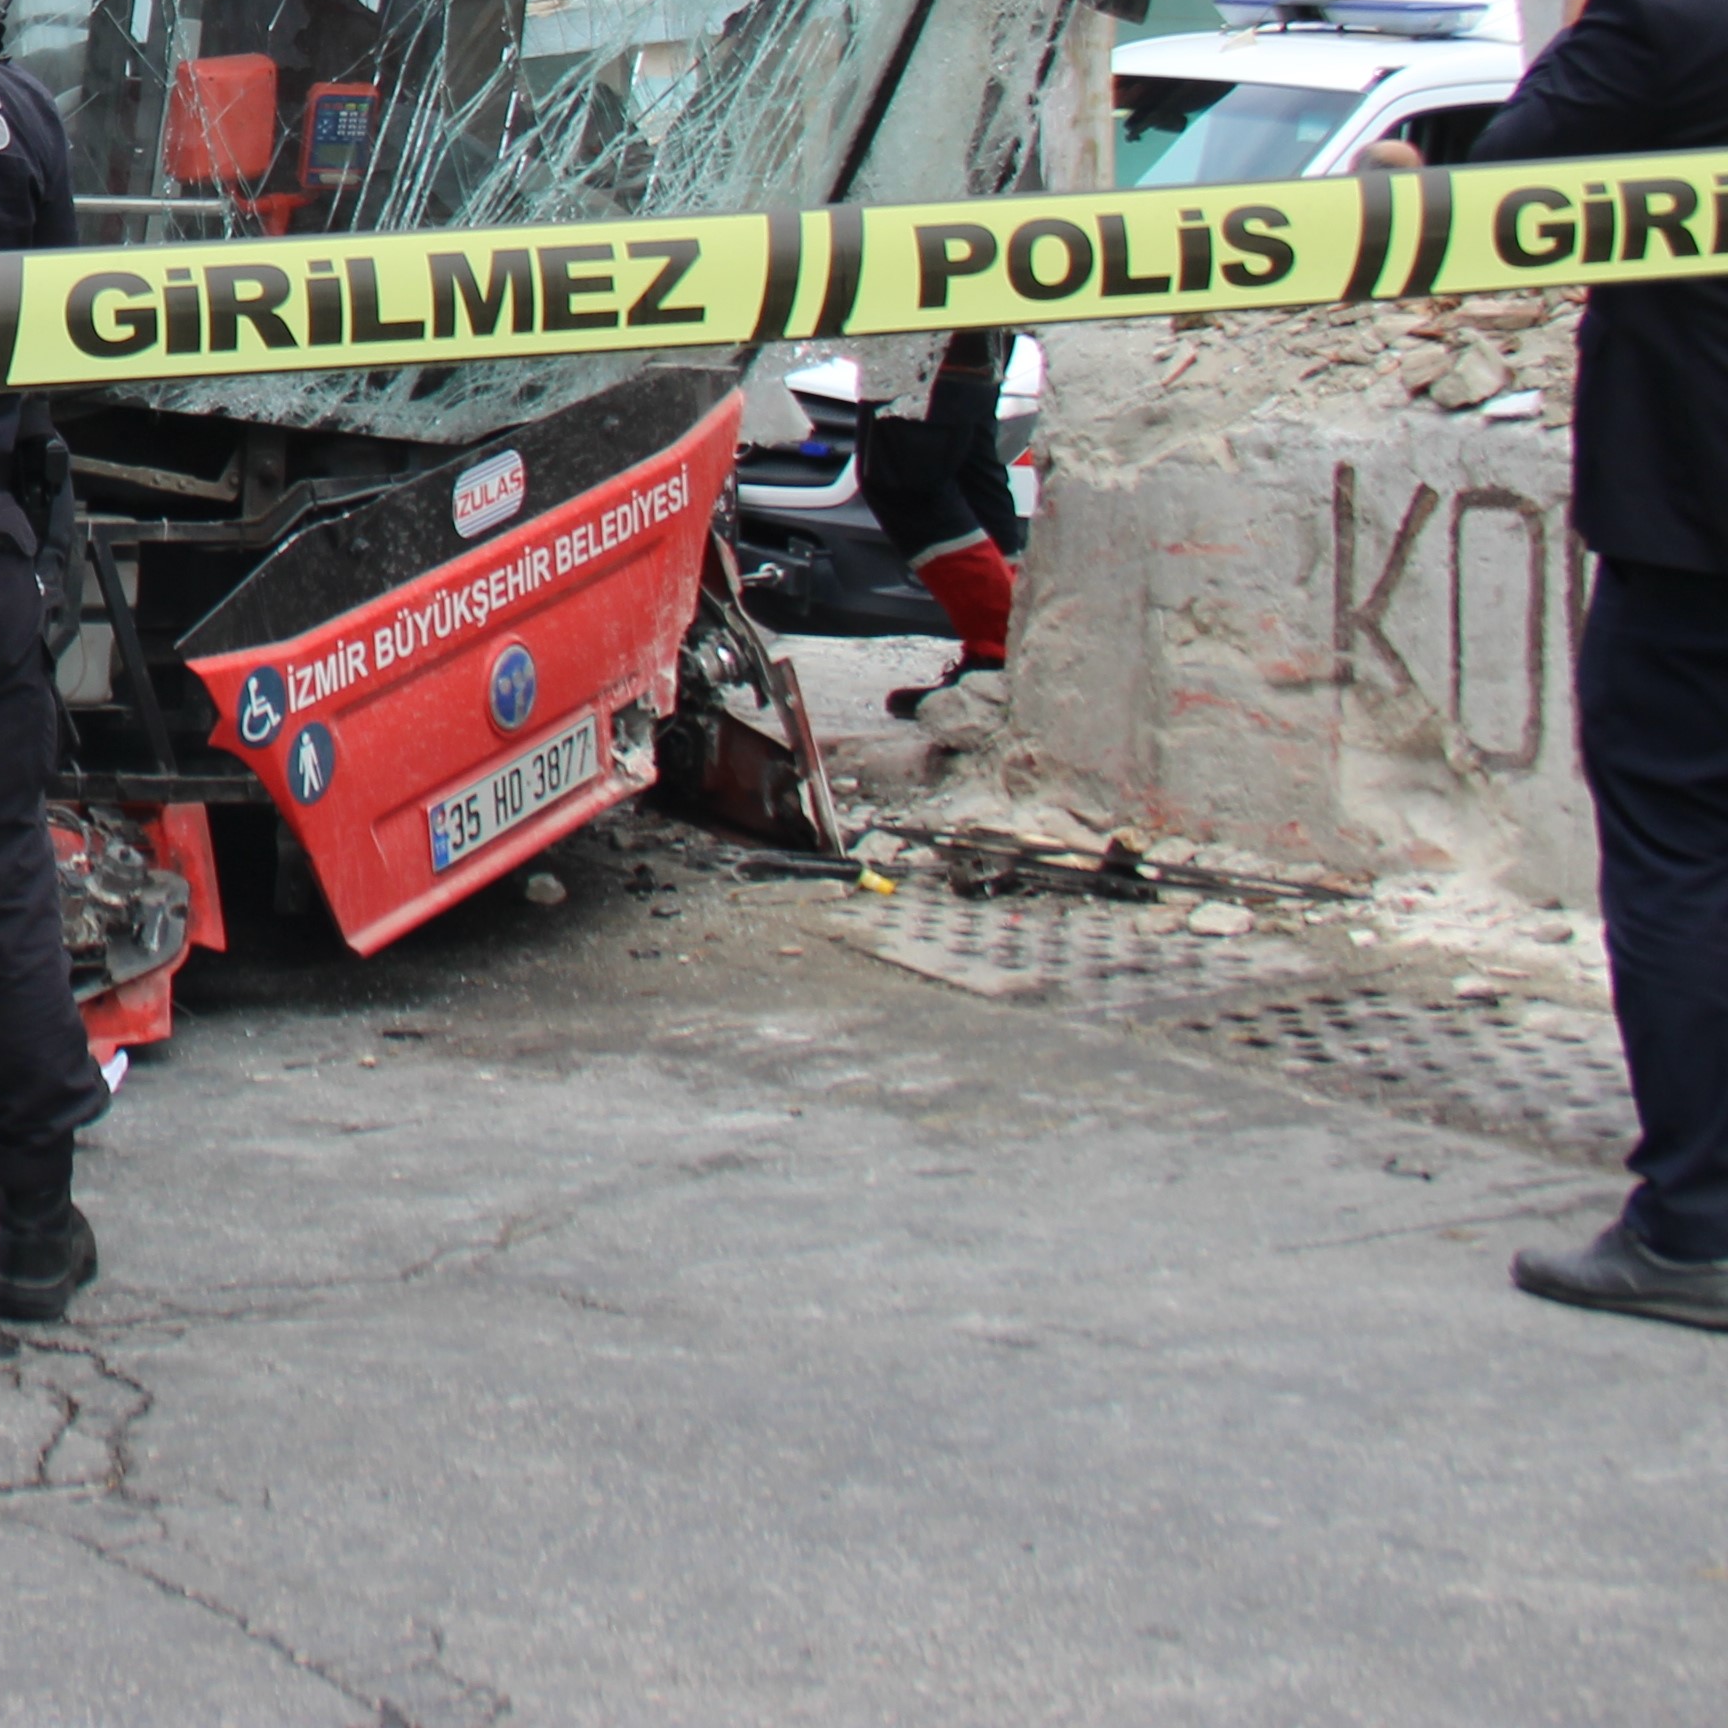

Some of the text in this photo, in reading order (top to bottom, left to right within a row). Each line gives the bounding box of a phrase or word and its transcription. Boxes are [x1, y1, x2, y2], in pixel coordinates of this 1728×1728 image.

[286, 638, 369, 713] İZMİR
[373, 545, 552, 671] BÜYÜKŞEHİR
[553, 462, 690, 575] BELEDİYESİ
[449, 791, 482, 853] 35
[531, 725, 590, 801] 3877
